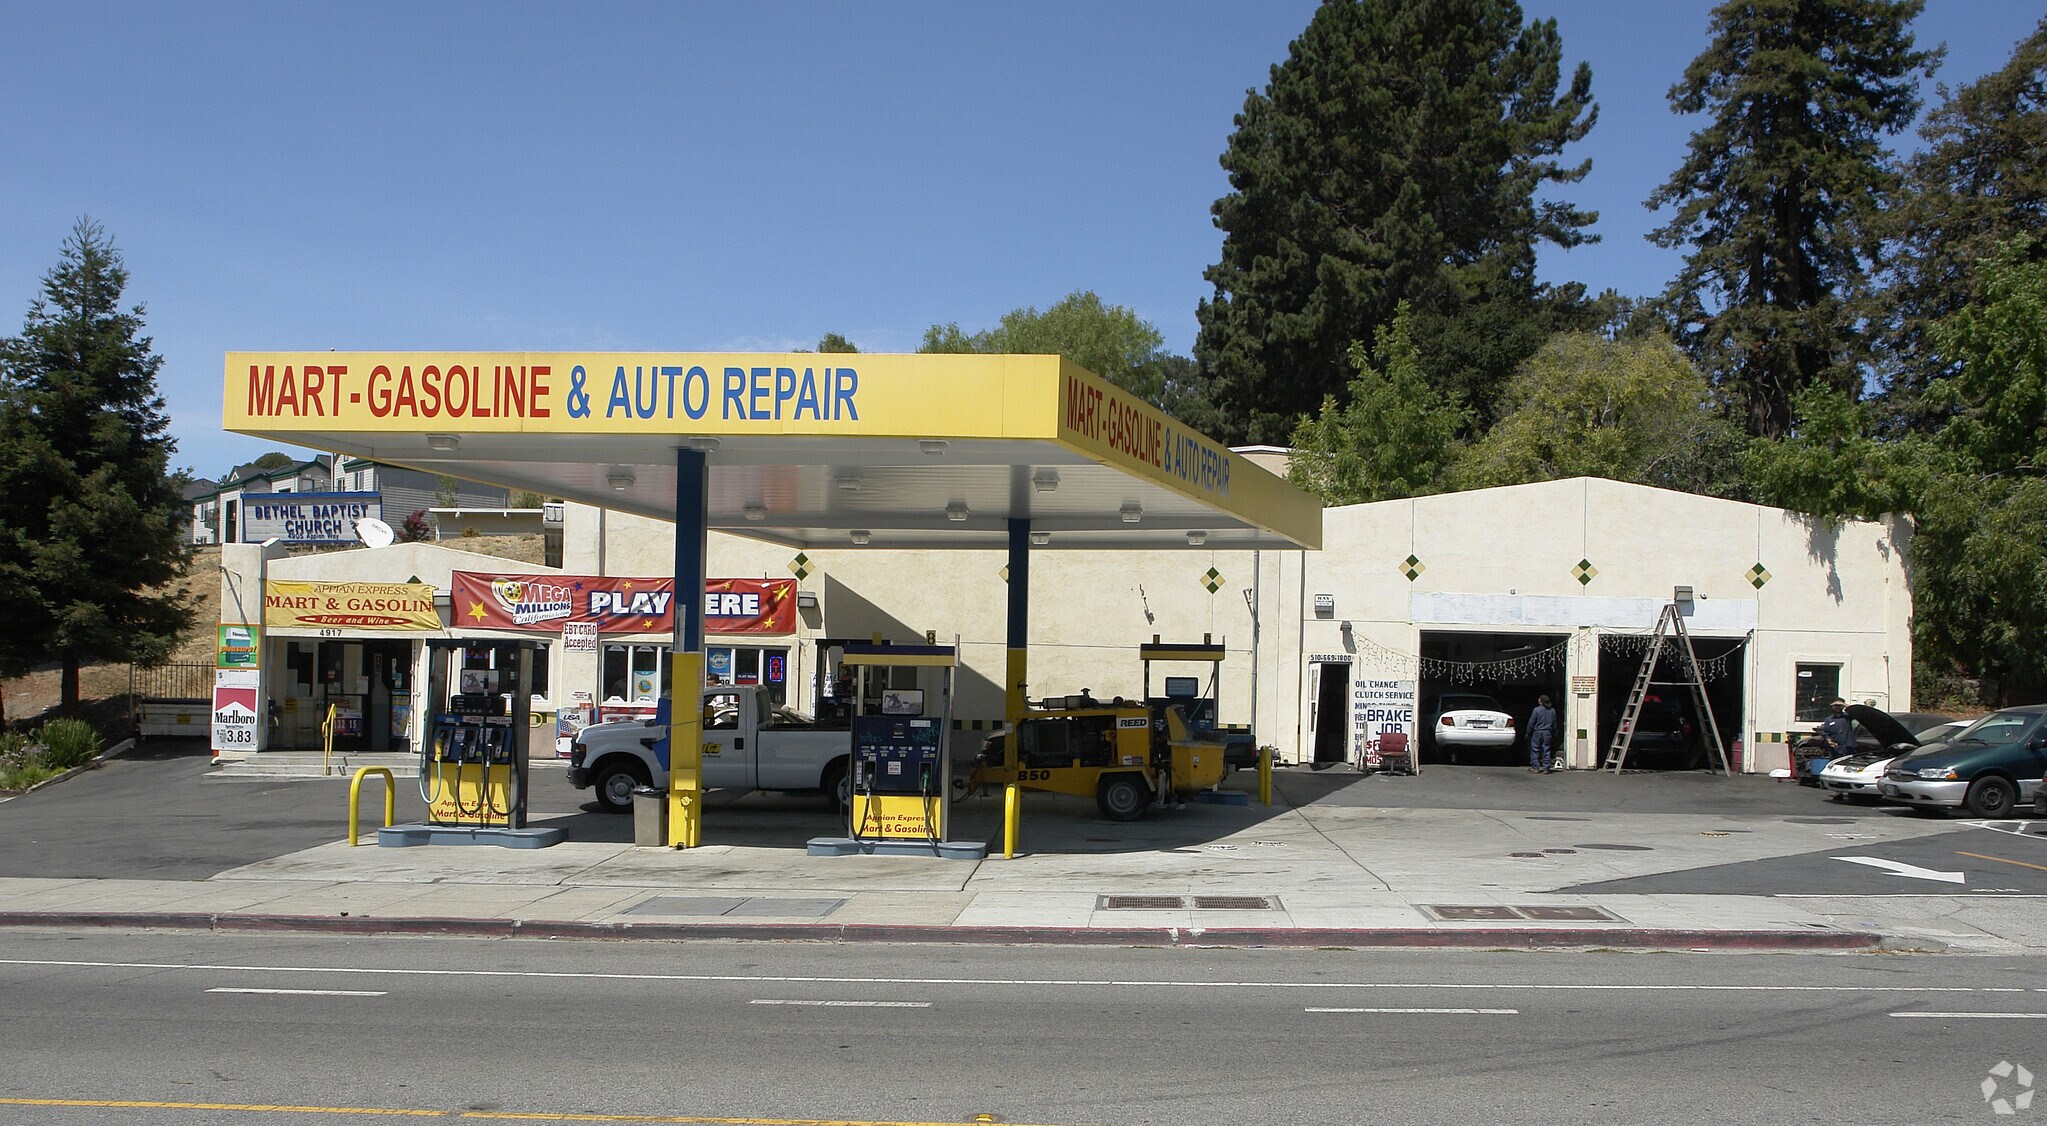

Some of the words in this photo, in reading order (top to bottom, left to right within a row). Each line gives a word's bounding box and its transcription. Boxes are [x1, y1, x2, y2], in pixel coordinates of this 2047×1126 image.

[248, 364, 551, 418] MART-GASOLINE
[568, 364, 592, 419] &
[606, 366, 710, 420] AUTO
[723, 366, 858, 422] REPAIR
[1066, 376, 1162, 468] MART-GASOLINE
[1164, 426, 1172, 472] &
[1174, 432, 1199, 486] AUTO
[1202, 448, 1230, 496] REPAIR
[254, 505, 306, 520] BETHEL
[312, 504, 368, 520] BAPTIST
[284, 520, 342, 534] CHURCH
[314, 584, 356, 594] APPIAN
[358, 586, 408, 596] EXPRESS
[520, 583, 570, 602] MEGA
[266, 596, 320, 610] MART
[326, 598, 340, 610] &
[515, 602, 570, 614] MILLIONS
[590, 591, 672, 615] PLAY
[704, 592, 760, 616] ERE
[320, 616, 342, 624] Beer
[366, 617, 390, 625] Wine
[514, 614, 555, 624] California
[564, 624, 578, 634] EBT
[578, 624, 596, 636] CARD
[564, 636, 596, 648] Accepted
[927, 632, 936, 645] 8
[772, 658, 780, 680] ATM
[1355, 680, 1367, 688] OIL
[215, 710, 255, 724] Marlboro
[1368, 710, 1412, 722] BRAKE
[1376, 723, 1402, 735] JOB
[227, 730, 251, 742] 3.83
[1017, 770, 1050, 781] B50
[435, 809, 457, 818] Mart
[885, 824, 892, 832] &
